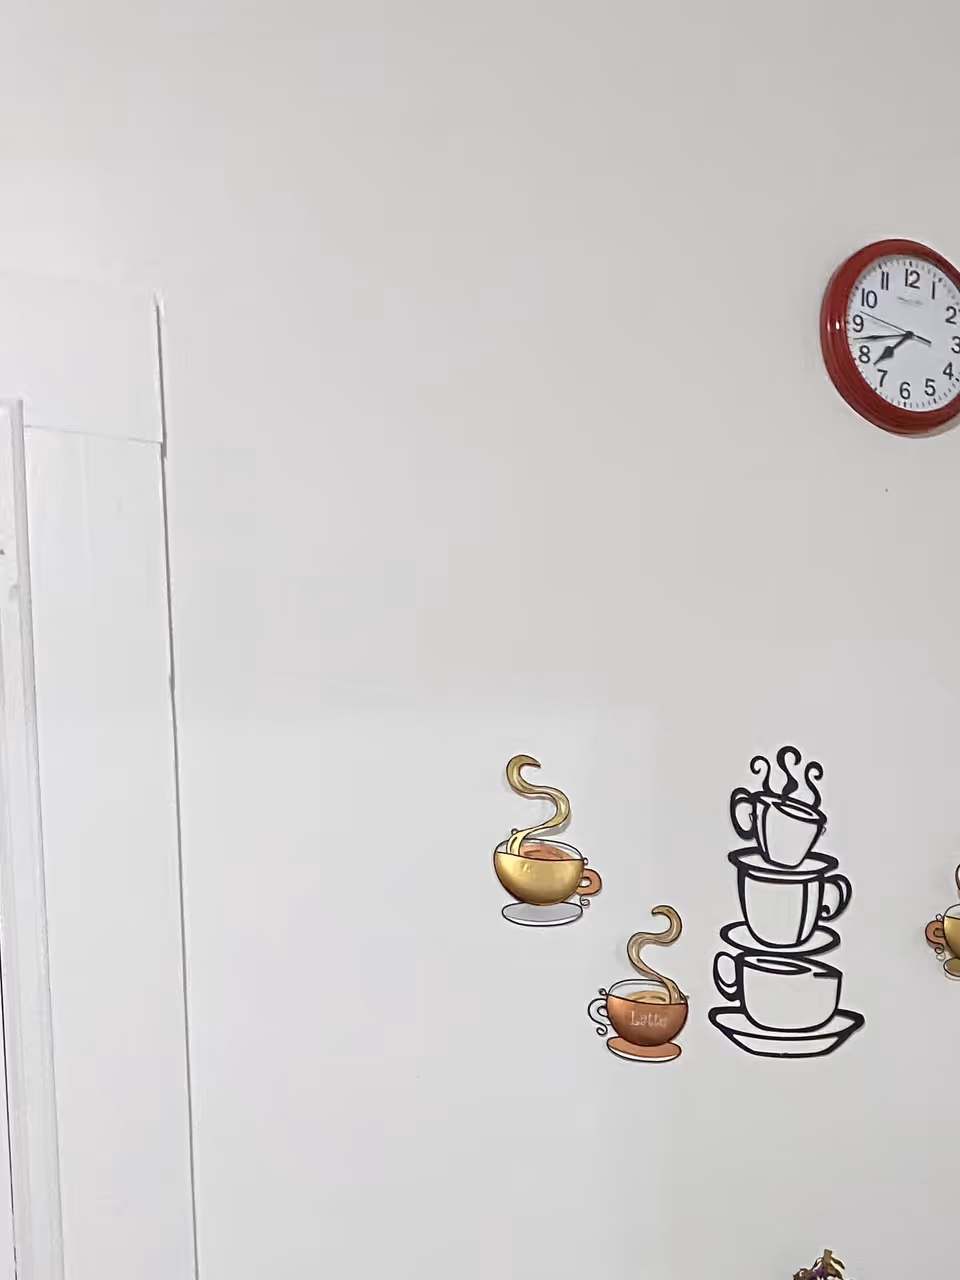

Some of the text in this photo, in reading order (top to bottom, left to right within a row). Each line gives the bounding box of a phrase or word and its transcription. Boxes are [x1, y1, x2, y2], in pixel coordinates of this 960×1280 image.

[881, 271, 889, 290] 11
[905, 269, 921, 289] 12
[861, 288, 878, 309] 10
[931, 281, 936, 300] 1
[853, 314, 864, 333] 9
[945, 306, 957, 325] 2
[858, 345, 870, 364] 8
[877, 369, 888, 388] 7
[943, 362, 954, 380] 4
[900, 381, 911, 400] 6
[924, 378, 936, 397] 5
[630, 1010, 668, 1028] Latte
